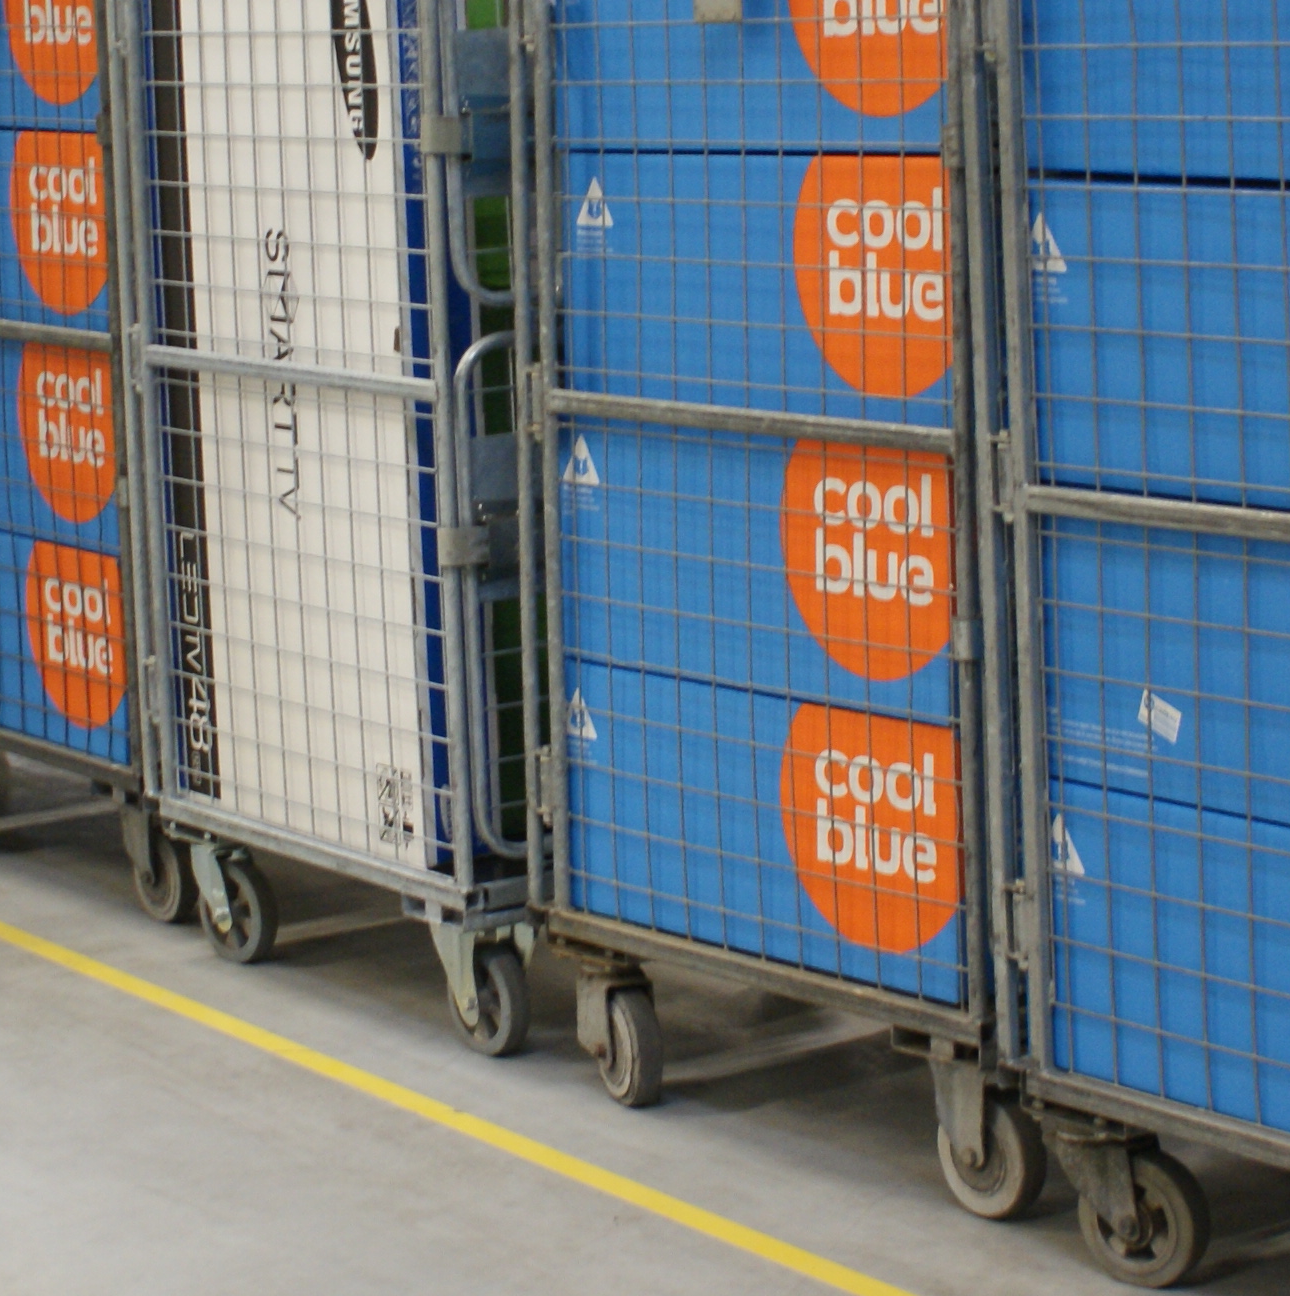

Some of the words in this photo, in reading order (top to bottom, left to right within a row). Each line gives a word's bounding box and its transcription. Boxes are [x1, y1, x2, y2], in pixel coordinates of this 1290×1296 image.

[29, 157, 97, 204] cool
[30, 208, 99, 259] blue
[826, 187, 943, 251] cool
[828, 250, 945, 322] blue
[35, 366, 103, 416] cool
[38, 416, 106, 469] blue
[276, 457, 301, 520] TV
[814, 473, 933, 538] cool
[815, 529, 933, 607] blue
[44, 576, 111, 627] cool
[47, 618, 114, 676] blue
[184, 632, 202, 672] TV
[188, 678, 211, 753] 48
[815, 748, 936, 817] cool
[816, 798, 937, 885] blue
